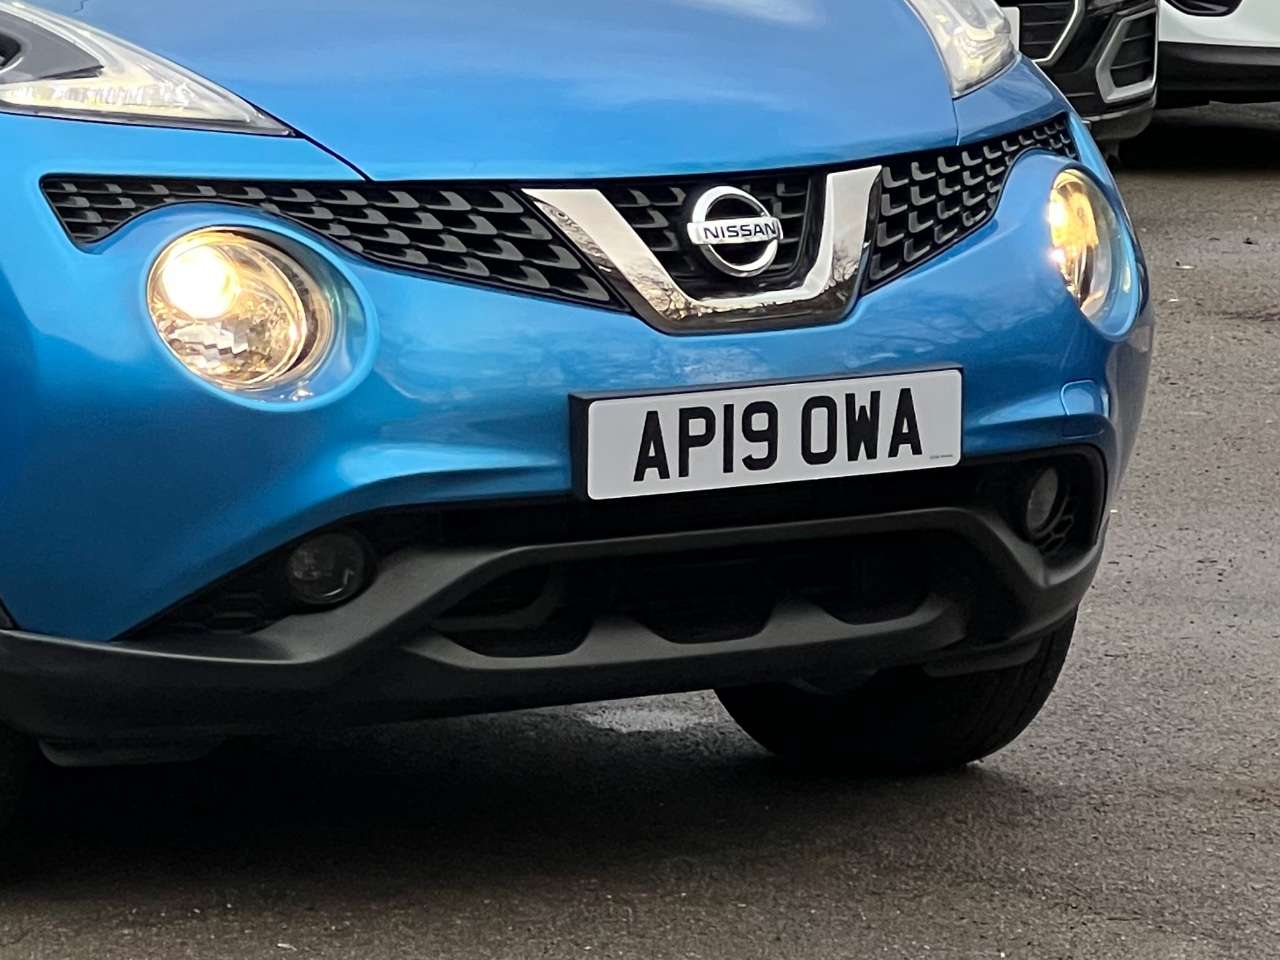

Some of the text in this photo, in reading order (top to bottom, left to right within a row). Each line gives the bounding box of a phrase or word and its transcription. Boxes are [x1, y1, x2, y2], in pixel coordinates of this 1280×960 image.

[703, 223, 777, 239] NISSAN
[633, 388, 923, 482] AP19 OWA
